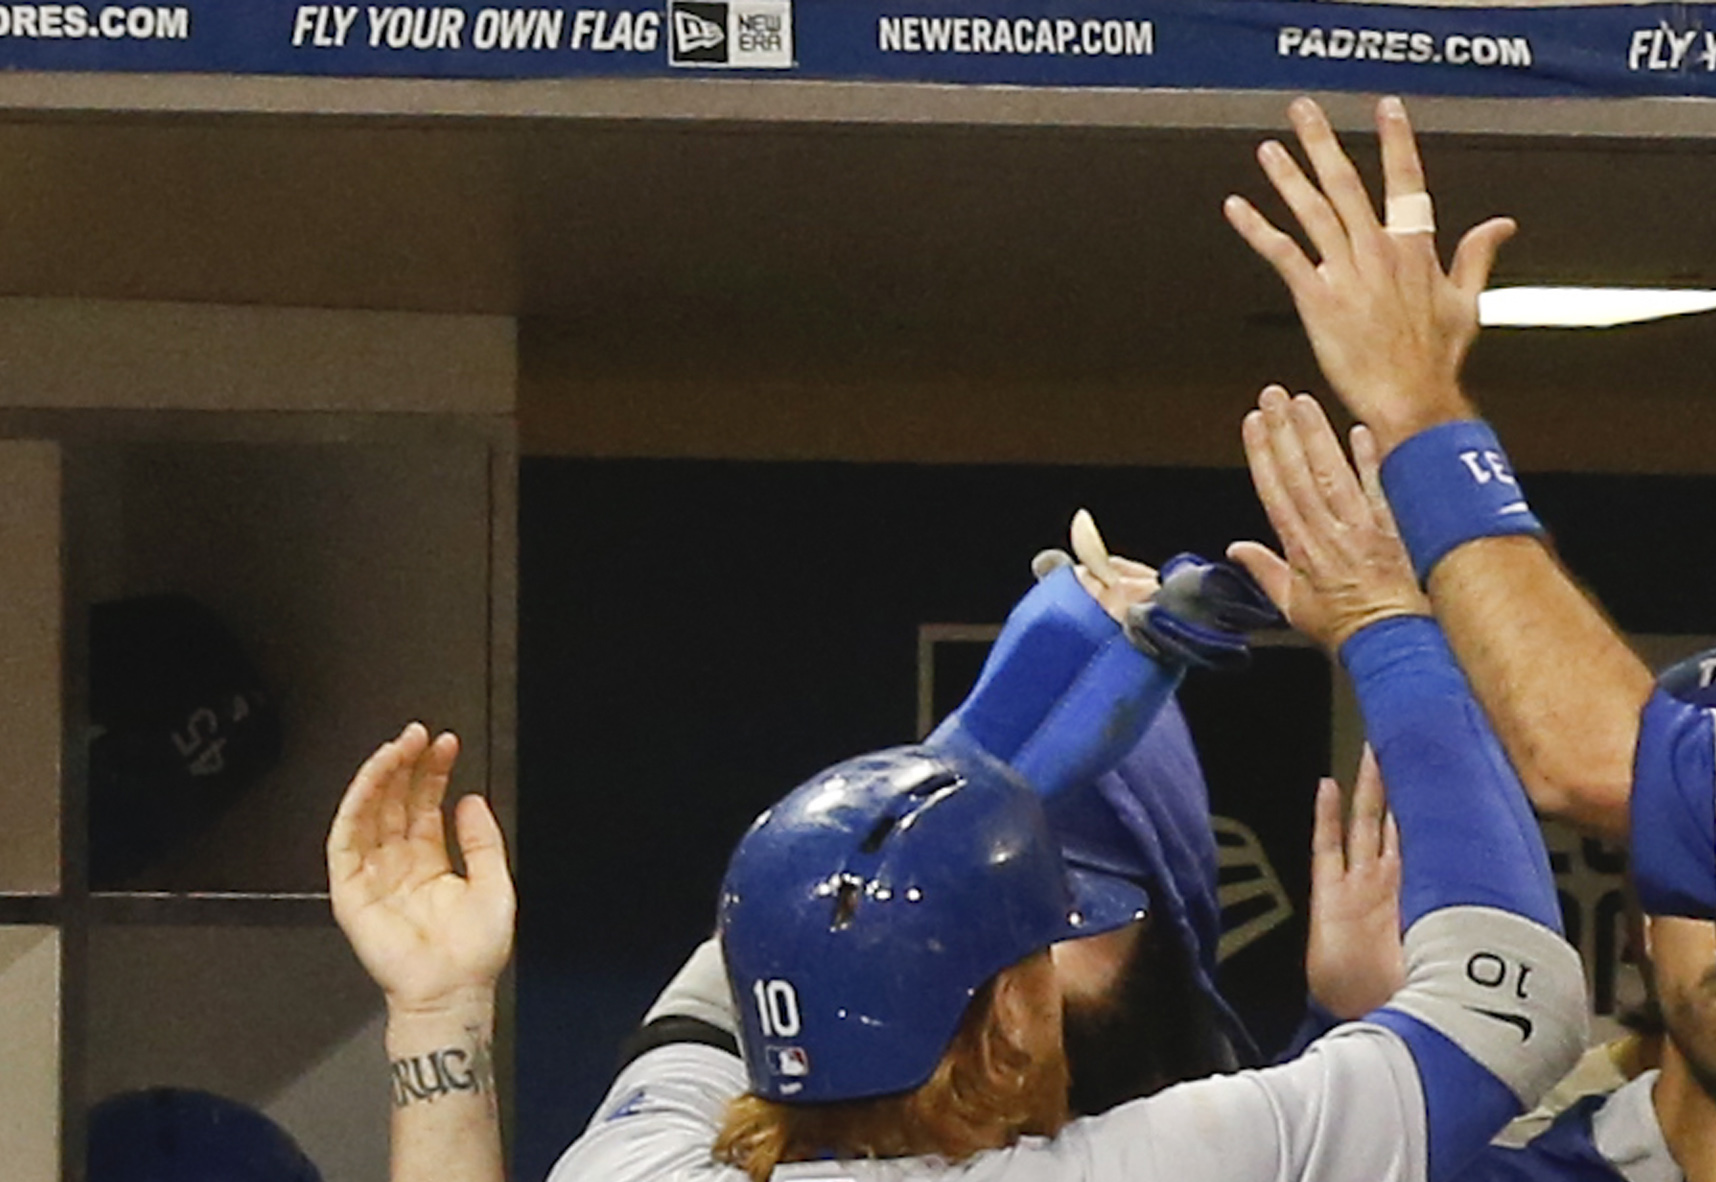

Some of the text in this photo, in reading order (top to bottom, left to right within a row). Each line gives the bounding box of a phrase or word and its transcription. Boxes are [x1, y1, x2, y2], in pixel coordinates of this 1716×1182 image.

[292, 6, 661, 51] FLY YOUR OWN FLAG
[738, 13, 782, 32] NEW
[739, 32, 782, 51] ERA
[879, 17, 1154, 56] NEWERACAP.COM
[1277, 26, 1532, 68] PADRES.COM
[1629, 27, 1697, 71] FLY
[753, 979, 800, 1038] 10
